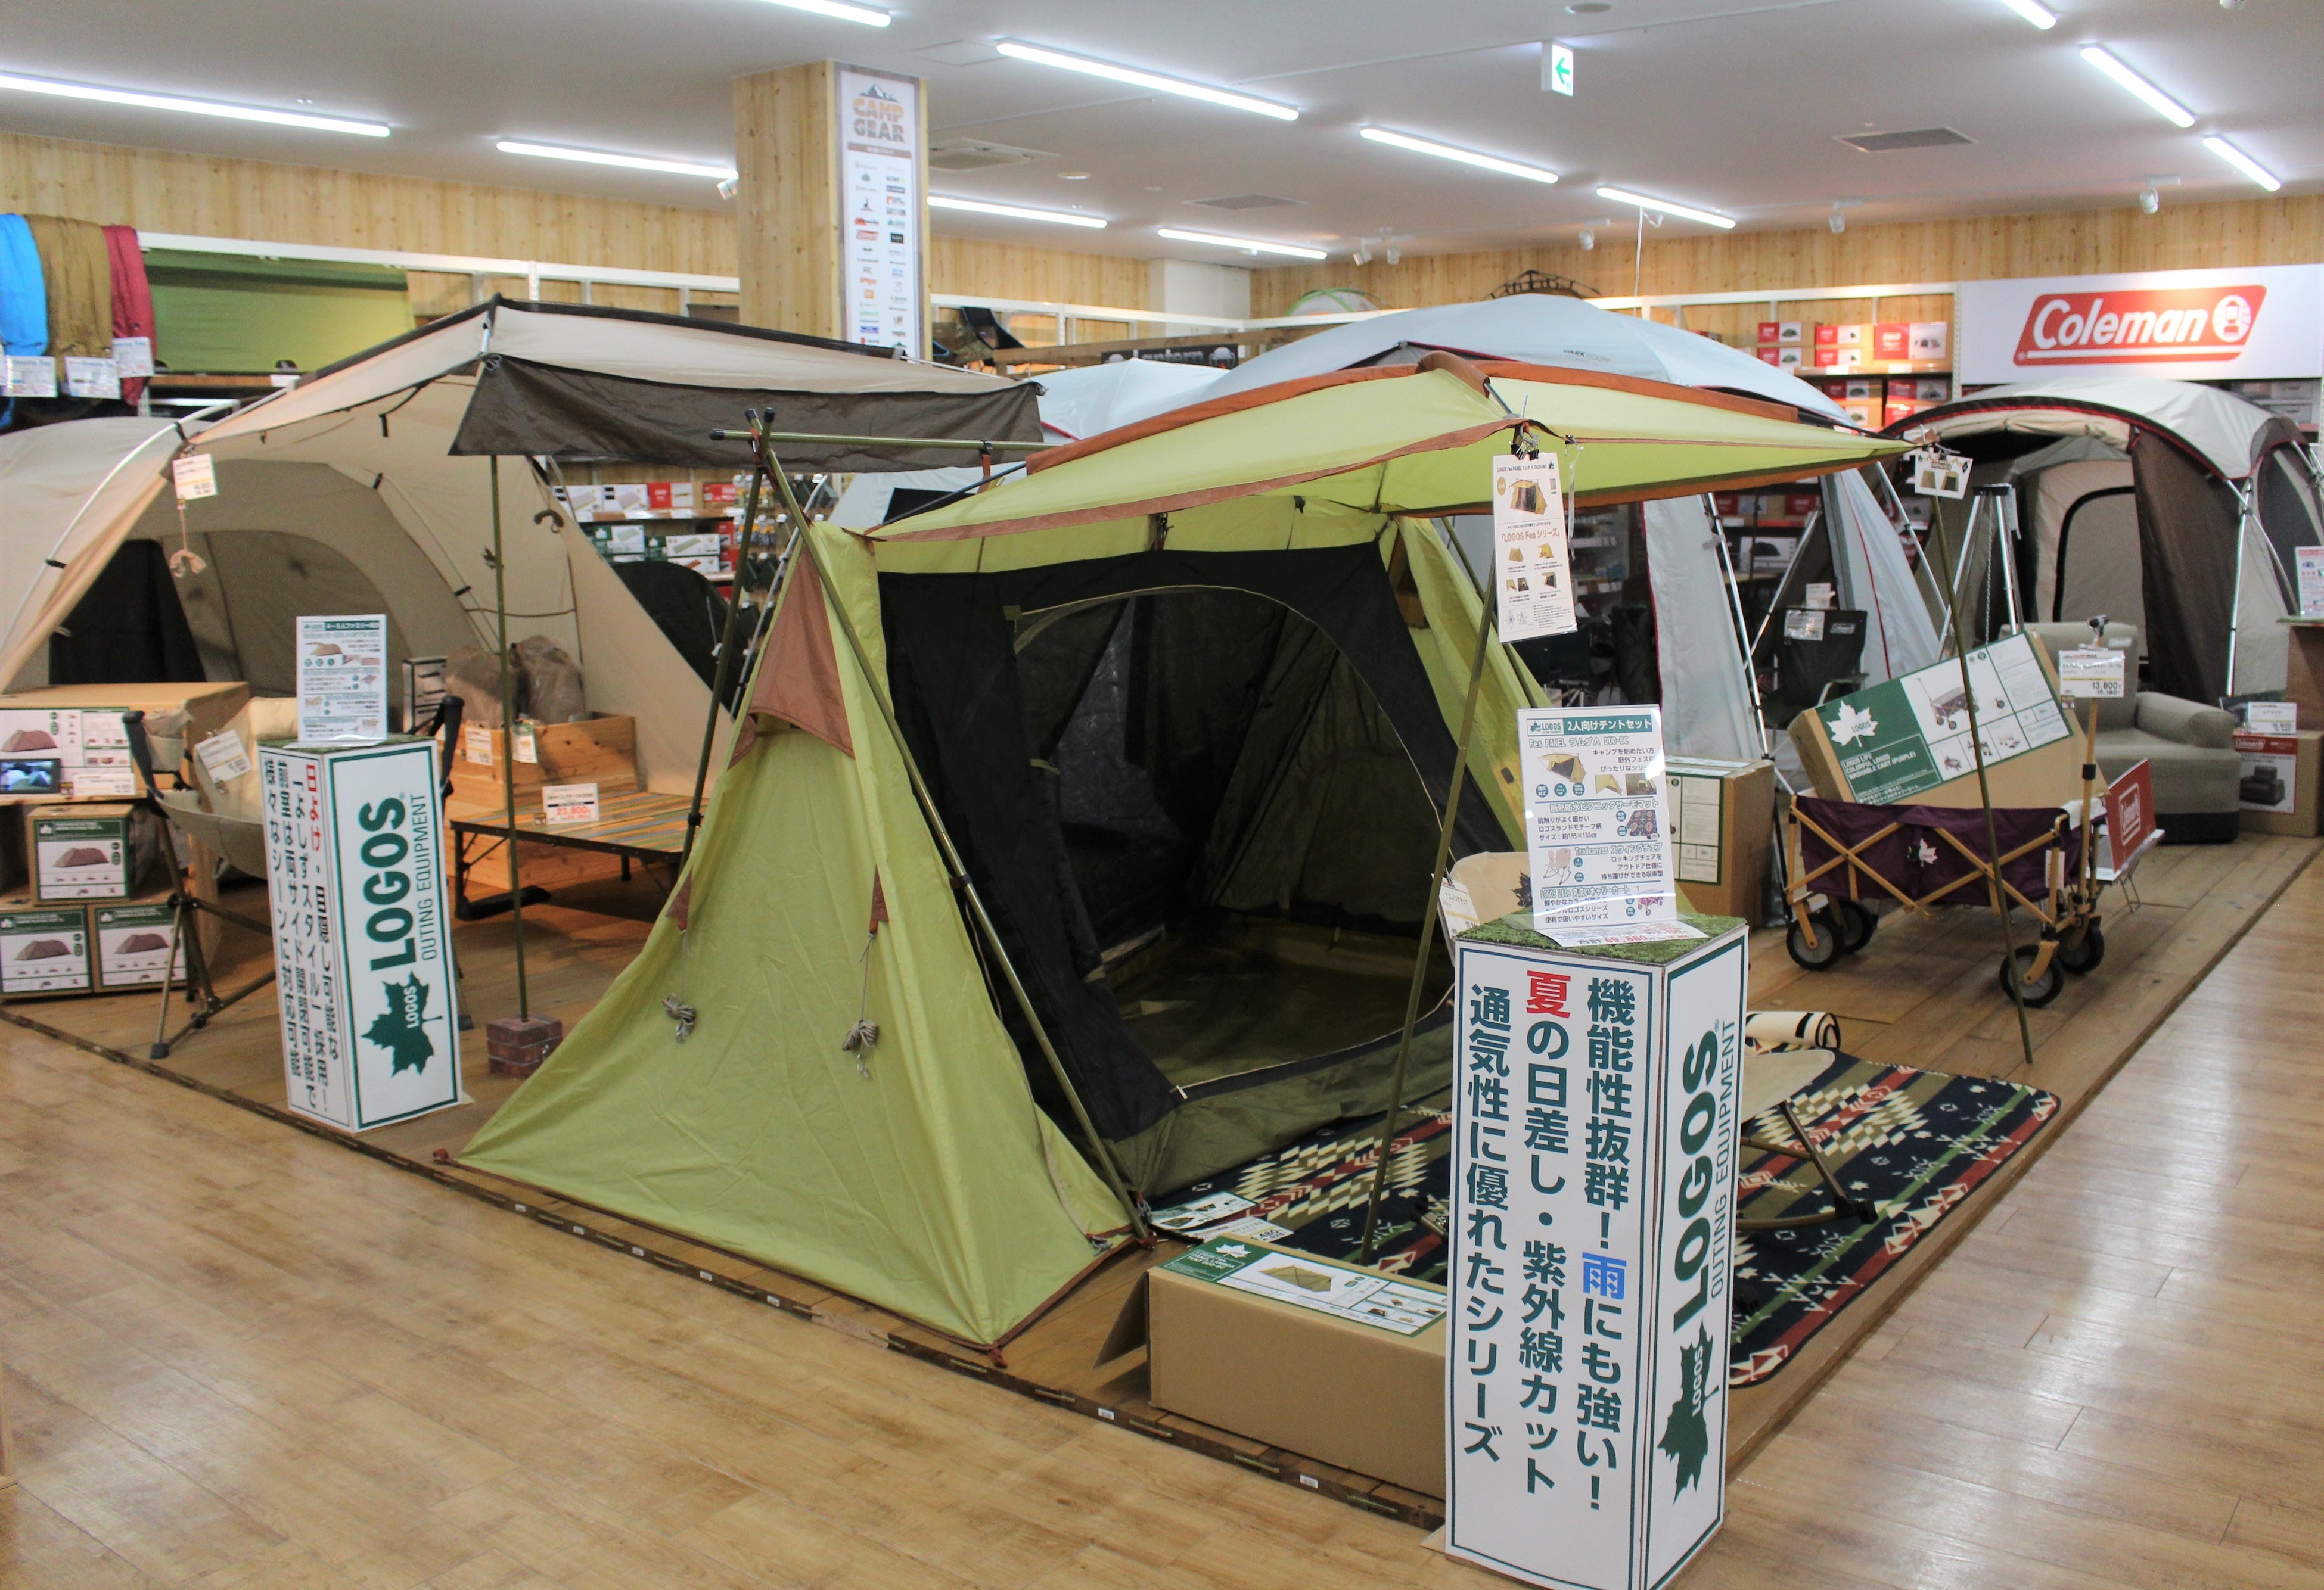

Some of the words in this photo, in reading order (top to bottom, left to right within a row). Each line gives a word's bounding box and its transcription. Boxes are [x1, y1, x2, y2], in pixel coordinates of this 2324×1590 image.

[853, 98, 905, 122] CAMP
[853, 117, 905, 142] GEAR
[2033, 298, 2208, 350] Coleman
[1542, 721, 1561, 730] LOGOS
[1567, 718, 1652, 732] 2人向けテントセット
[1851, 721, 1871, 732] LOGOS
[1529, 739, 1543, 748] Fes
[1545, 738, 1567, 748] PANEL
[1603, 736, 1629, 745] DUO-BC
[1592, 747, 1655, 756] キャンプを始めたい方
[1537, 816, 1590, 824] 肌触りがよく暖かい
[1539, 823, 1602, 833] ロゴスランドモチーフ柄
[410, 794, 432, 893] EQUIPMENT
[1574, 845, 1608, 856] Tradcanvas
[1610, 842, 1663, 854] スウィングチェア
[1611, 854, 1661, 863] ロッキングチェアを
[358, 797, 416, 972] LOGOS
[1601, 870, 1663, 880] 持ち運びができる収束型
[1540, 889, 1556, 899] LOGOS
[265, 758, 302, 1077] 様々なシーンに対応可能
[306, 764, 338, 1061] 日よけ・目隠し可能な
[1545, 905, 1608, 914] ルロゴスシリーズ
[1545, 913, 1608, 923] 便利で扱いやすいサイズ
[418, 897, 437, 961] OUTING
[403, 985, 420, 1029] LOGOS
[1716, 1019, 1736, 1186] EQUIPMENT
[1673, 1029, 1719, 1334] LOGOS
[1464, 984, 1512, 1463] 通気性に優れたシリーズ
[1519, 970, 1571, 1495] 夏の日差し・紫外線カット
[1576, 977, 1635, 1511] 機能性抜群！雨にも強い！
[1711, 1194, 1728, 1299] OUTING
[1692, 1345, 1704, 1417] LOGOS
